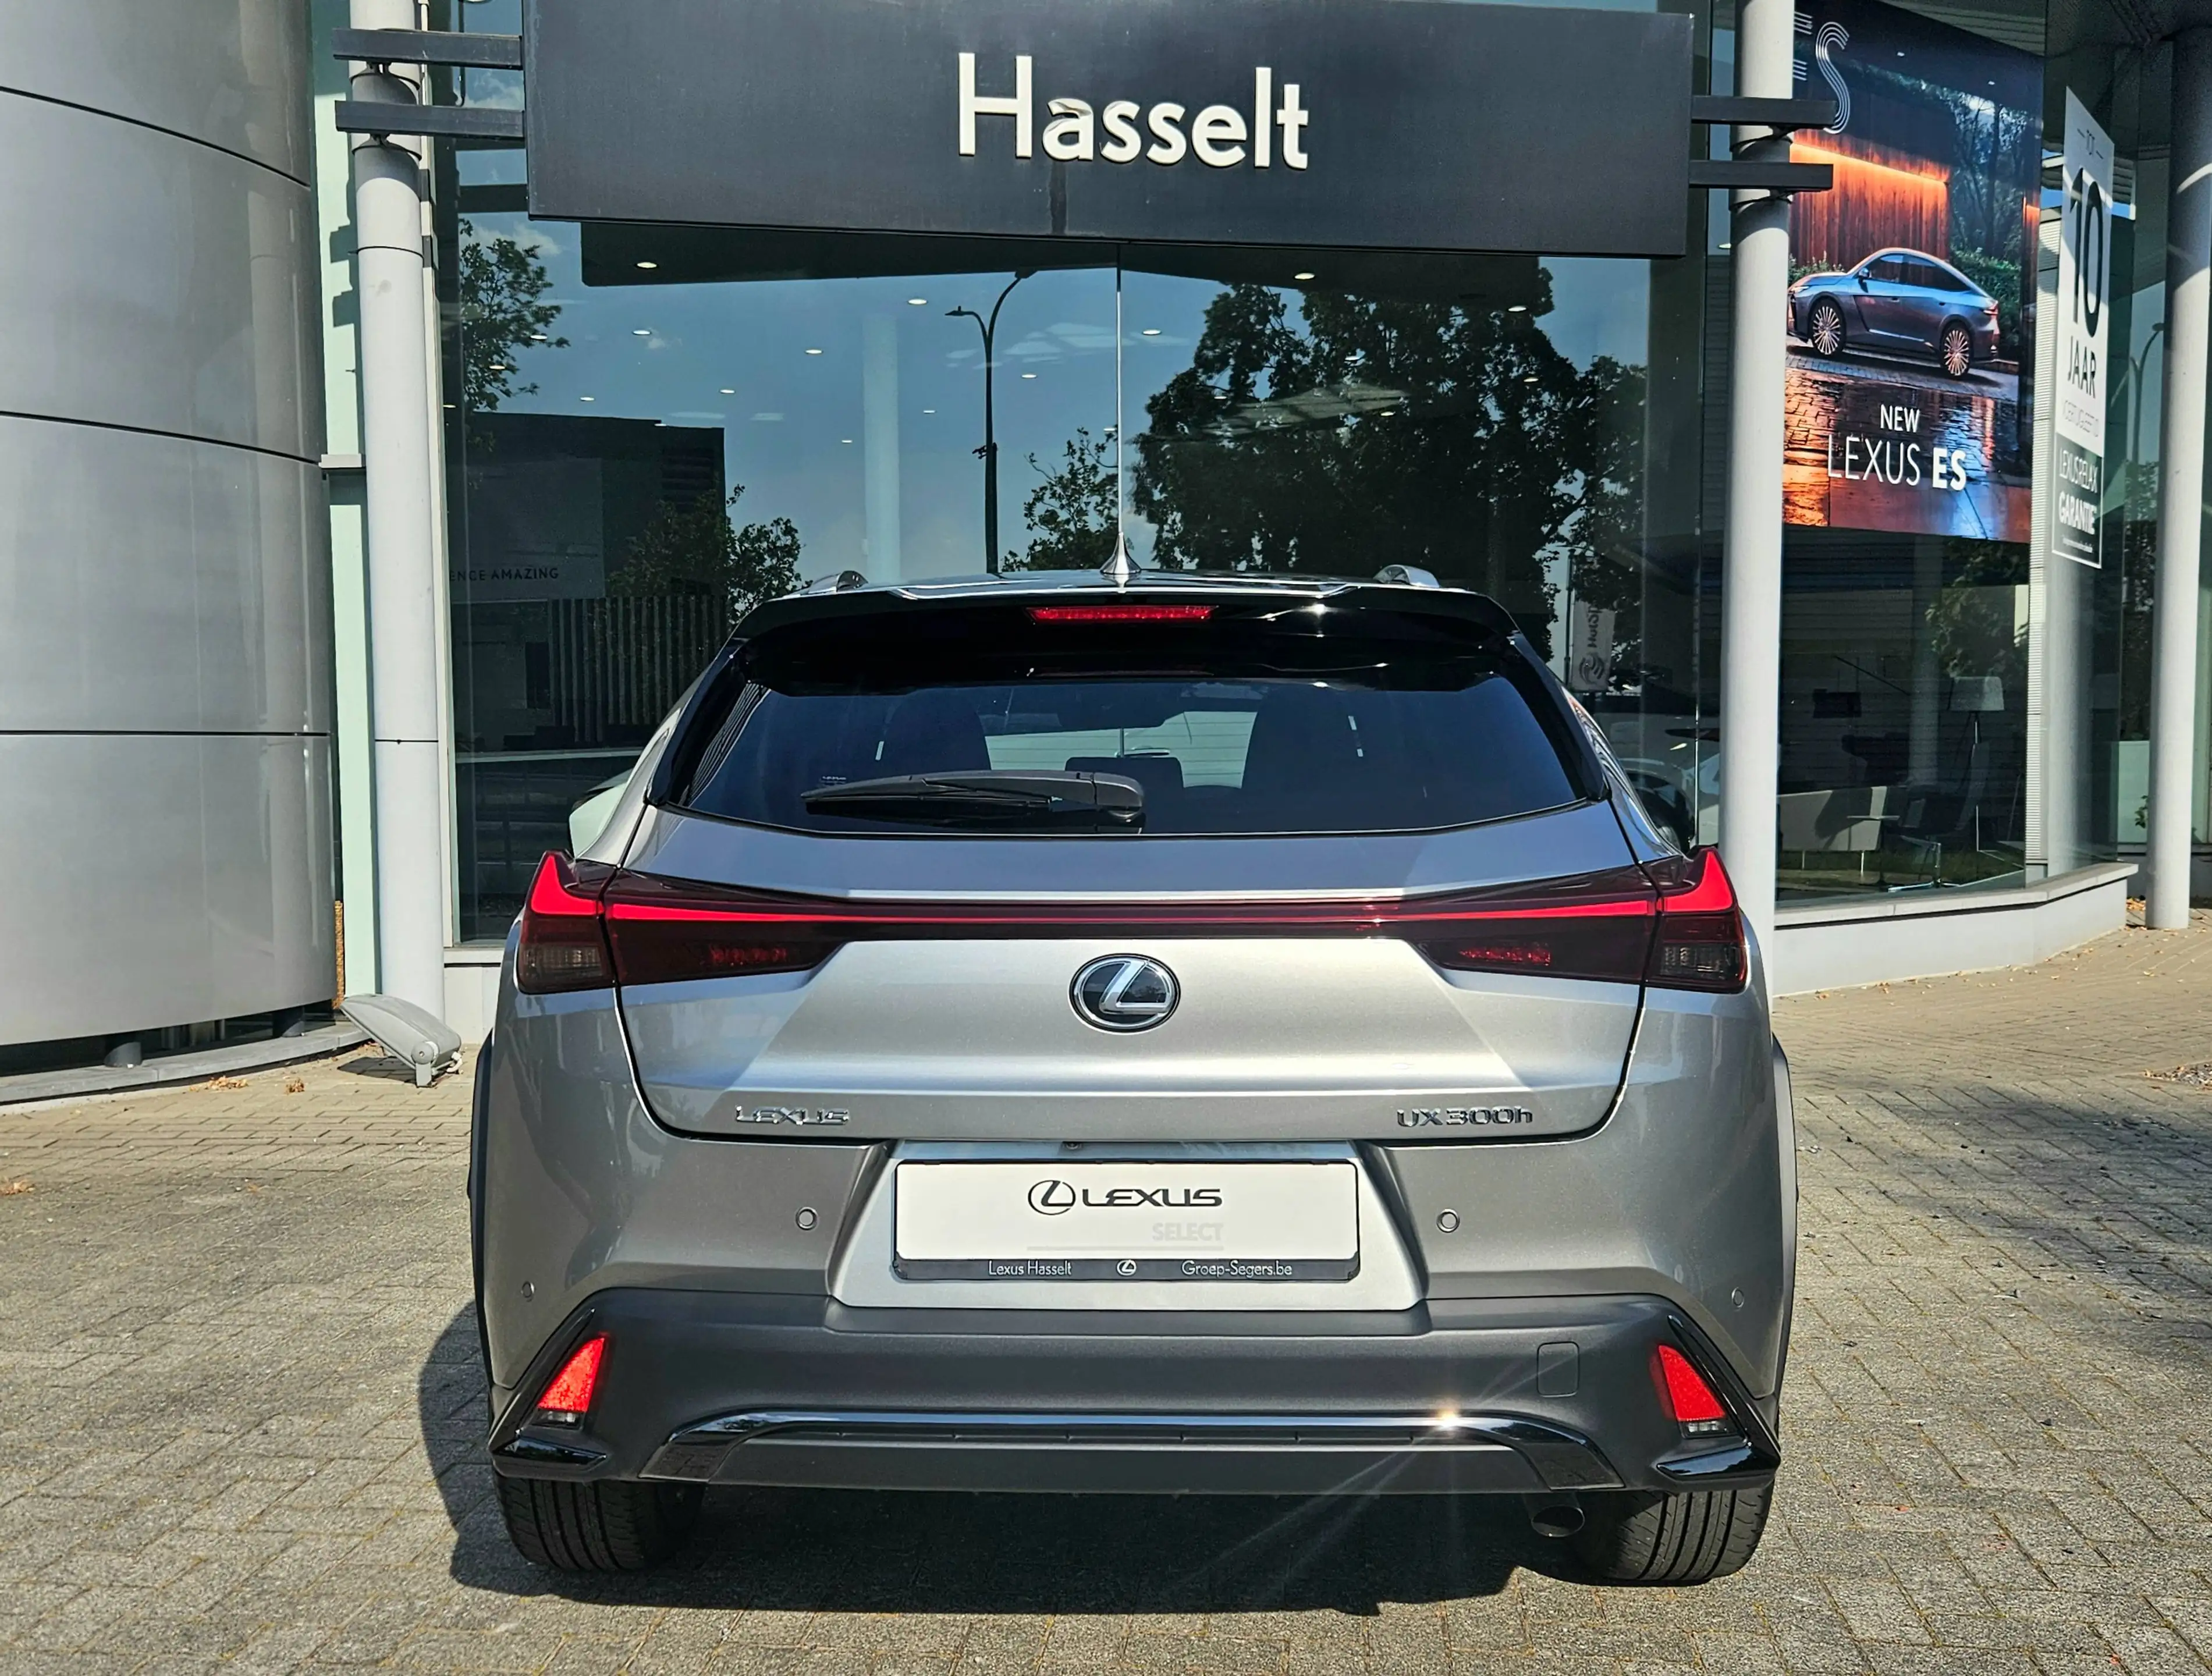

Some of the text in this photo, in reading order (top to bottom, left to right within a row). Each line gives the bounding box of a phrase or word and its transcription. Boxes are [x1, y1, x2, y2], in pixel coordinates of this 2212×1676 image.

[958, 52, 1309, 169] Hasselt
[2069, 167, 2104, 338] 10
[2067, 336, 2096, 399] JAAR
[1880, 404, 1920, 433] NEW
[1827, 434, 1966, 491] LEXUS ES
[491, 567, 559, 580] AMAZING
[735, 1106, 849, 1125] LEXUS
[1082, 1188, 1223, 1207] LEXUS
[1152, 1223, 1224, 1241] SELECT
[989, 1260, 1072, 1276] Lexus Hasselt
[1181, 1260, 1293, 1279] Groep-Segers.be
